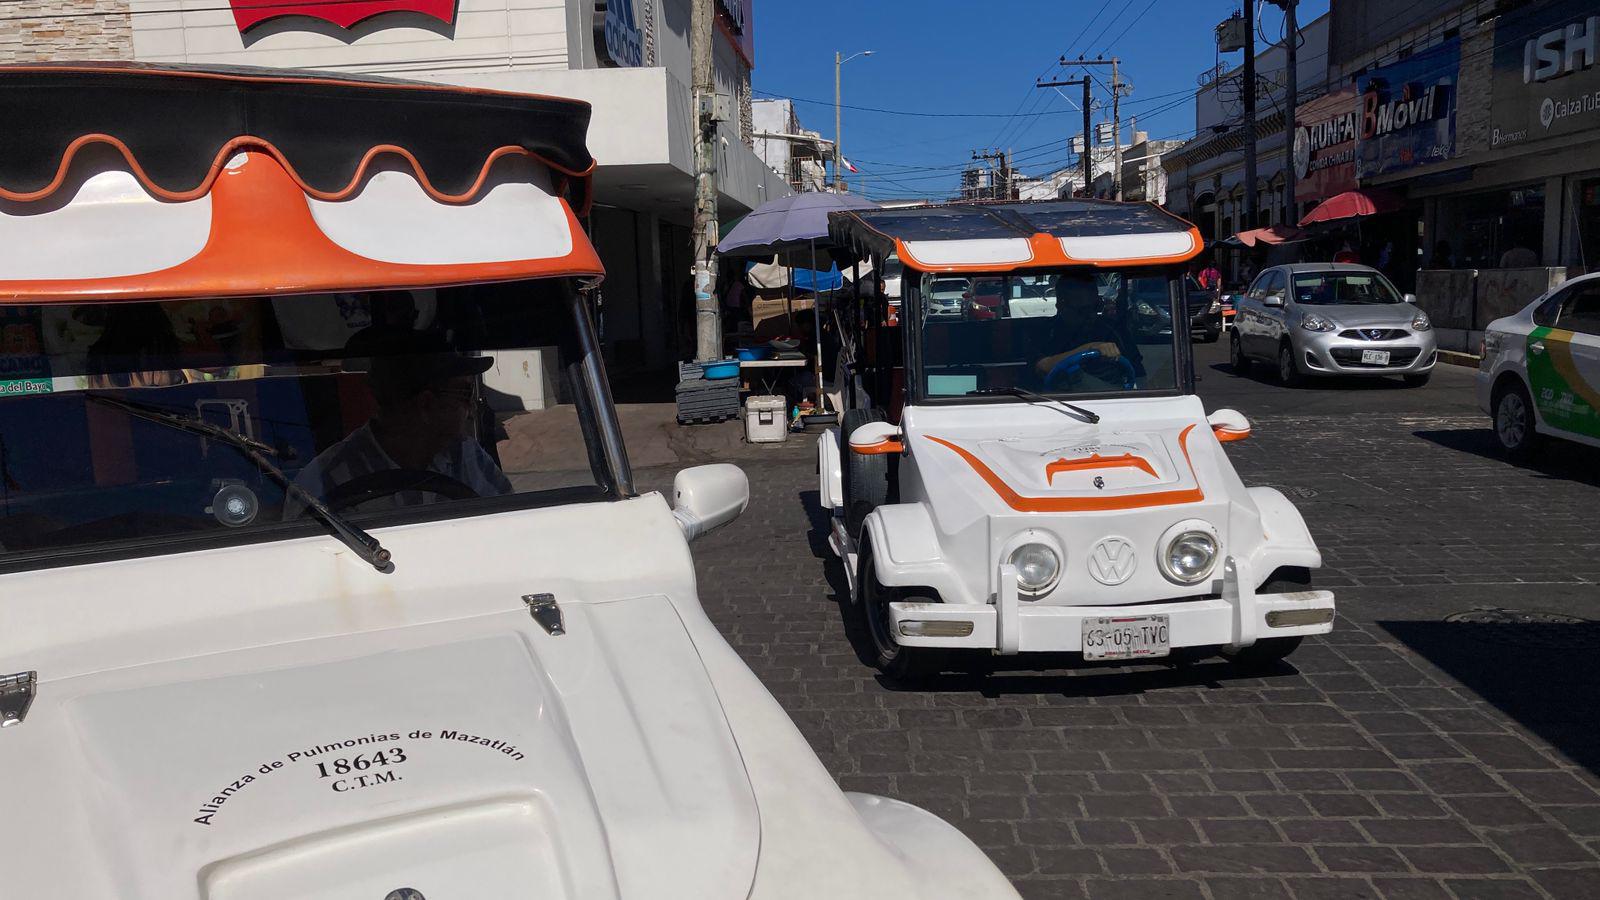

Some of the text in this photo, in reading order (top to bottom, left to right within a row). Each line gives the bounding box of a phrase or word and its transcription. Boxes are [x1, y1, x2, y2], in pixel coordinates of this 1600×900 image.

[605, 19, 642, 67] adidas
[194, 729, 526, 826] Alianza de Pulmonias de Mazatlán
[315, 747, 408, 779] 18643
[332, 770, 403, 792] C.T.M.
